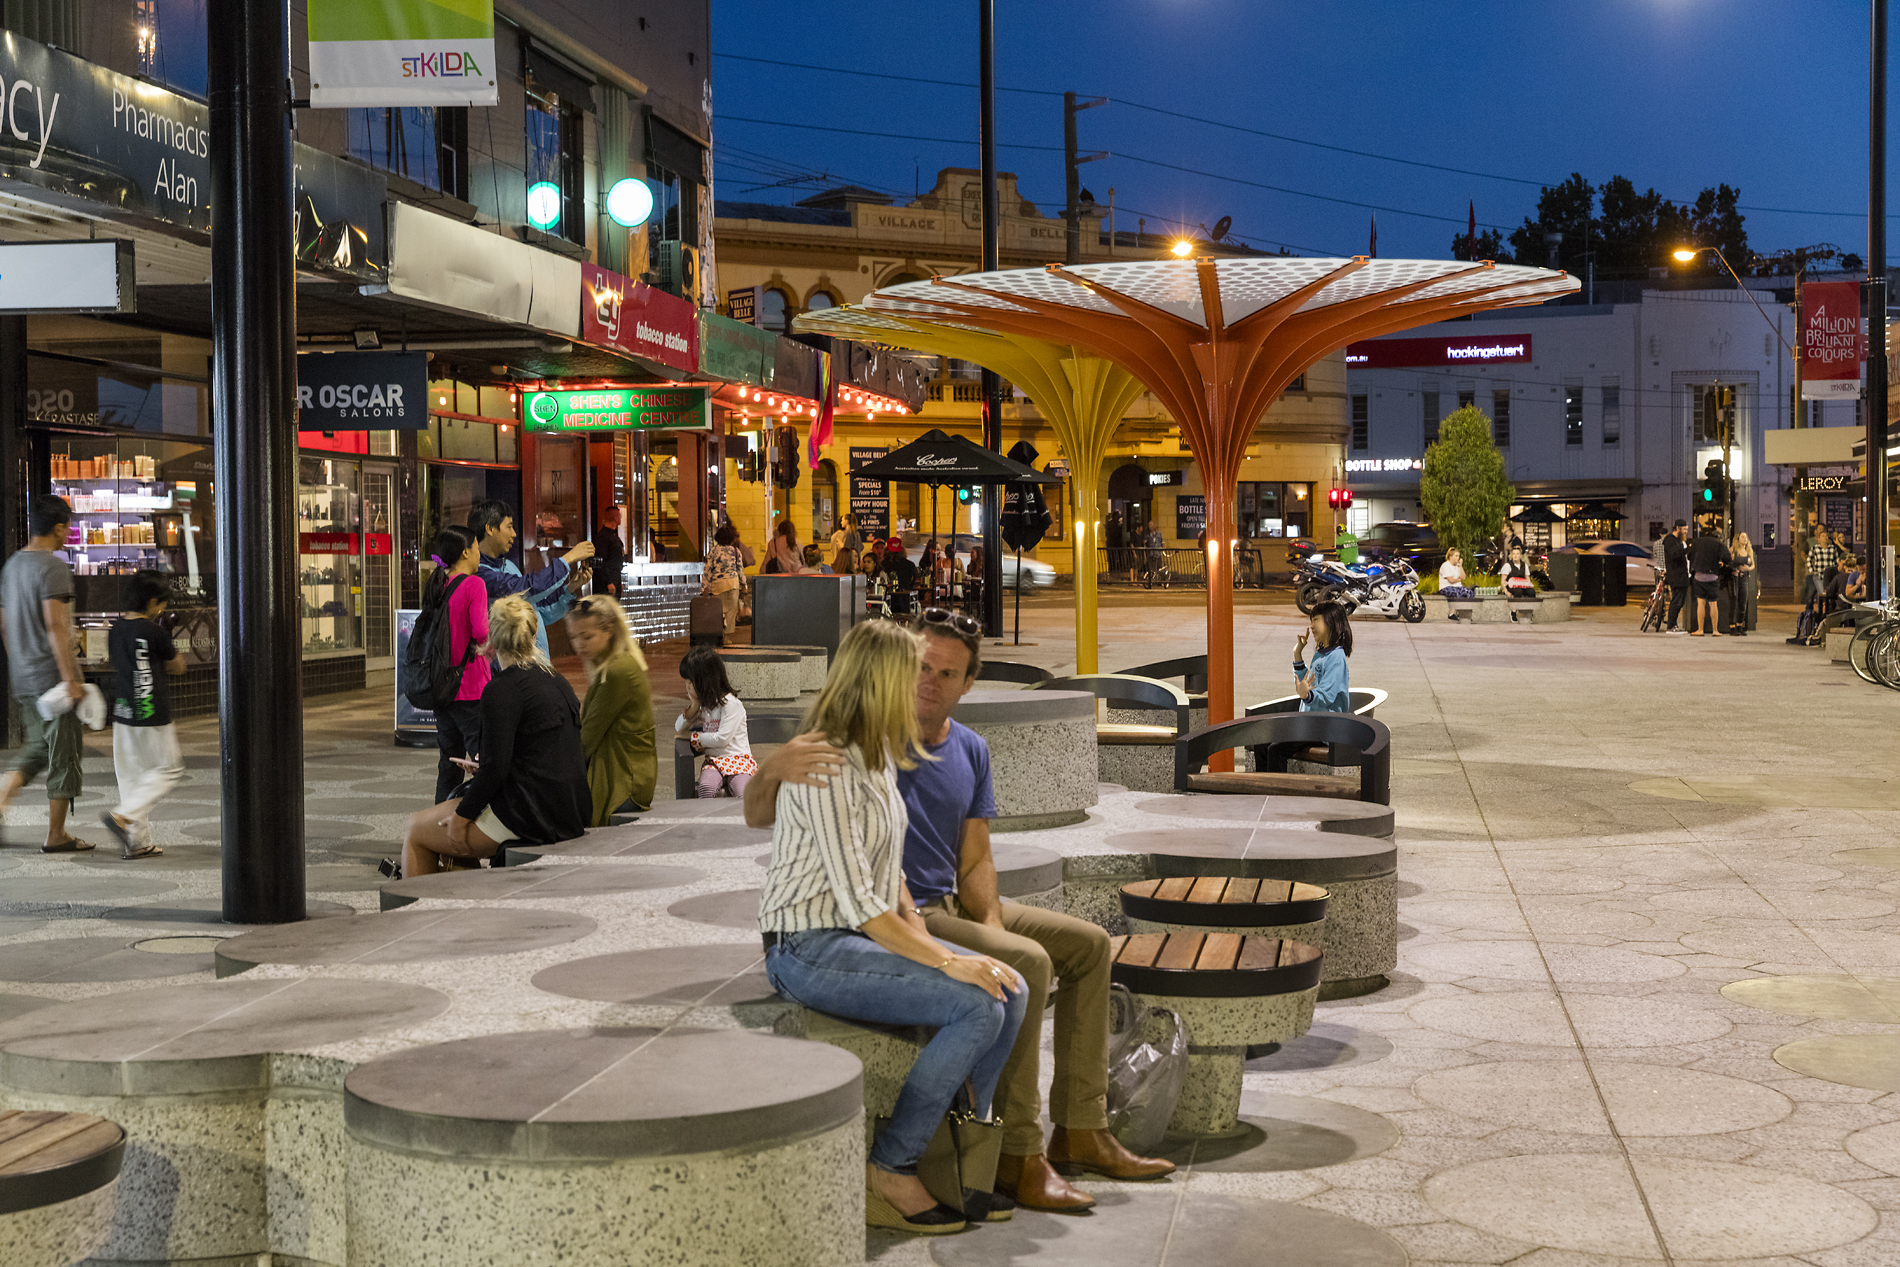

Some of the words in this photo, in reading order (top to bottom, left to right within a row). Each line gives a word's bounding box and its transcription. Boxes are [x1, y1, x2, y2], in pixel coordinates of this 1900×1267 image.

[112, 88, 210, 158] Pharmacis
[154, 157, 197, 207] Alan
[879, 216, 936, 230] VILLAGE
[729, 297, 754, 309] VILLAGE
[733, 307, 752, 318] BELLE
[1815, 304, 1826, 317] A
[636, 320, 664, 347] tobacco
[664, 331, 688, 354] station
[1447, 344, 1524, 359] hockingstuart
[1808, 347, 1855, 363] COLOURS
[319, 383, 405, 409] OSCAR
[569, 394, 623, 410] SHEN'S
[629, 392, 694, 408] CHINESE
[340, 407, 406, 418] SALONS
[534, 404, 556, 413] SHEN
[563, 412, 632, 428] MEDICINE
[639, 410, 700, 425] CENTRE
[916, 454, 957, 466] Coopers
[1345, 460, 1382, 471] BOTTLE
[1383, 459, 1412, 471] SHOP
[1149, 474, 1171, 485] POKIES
[1800, 476, 1844, 490] LEROY
[1179, 505, 1203, 514] BOTTLE
